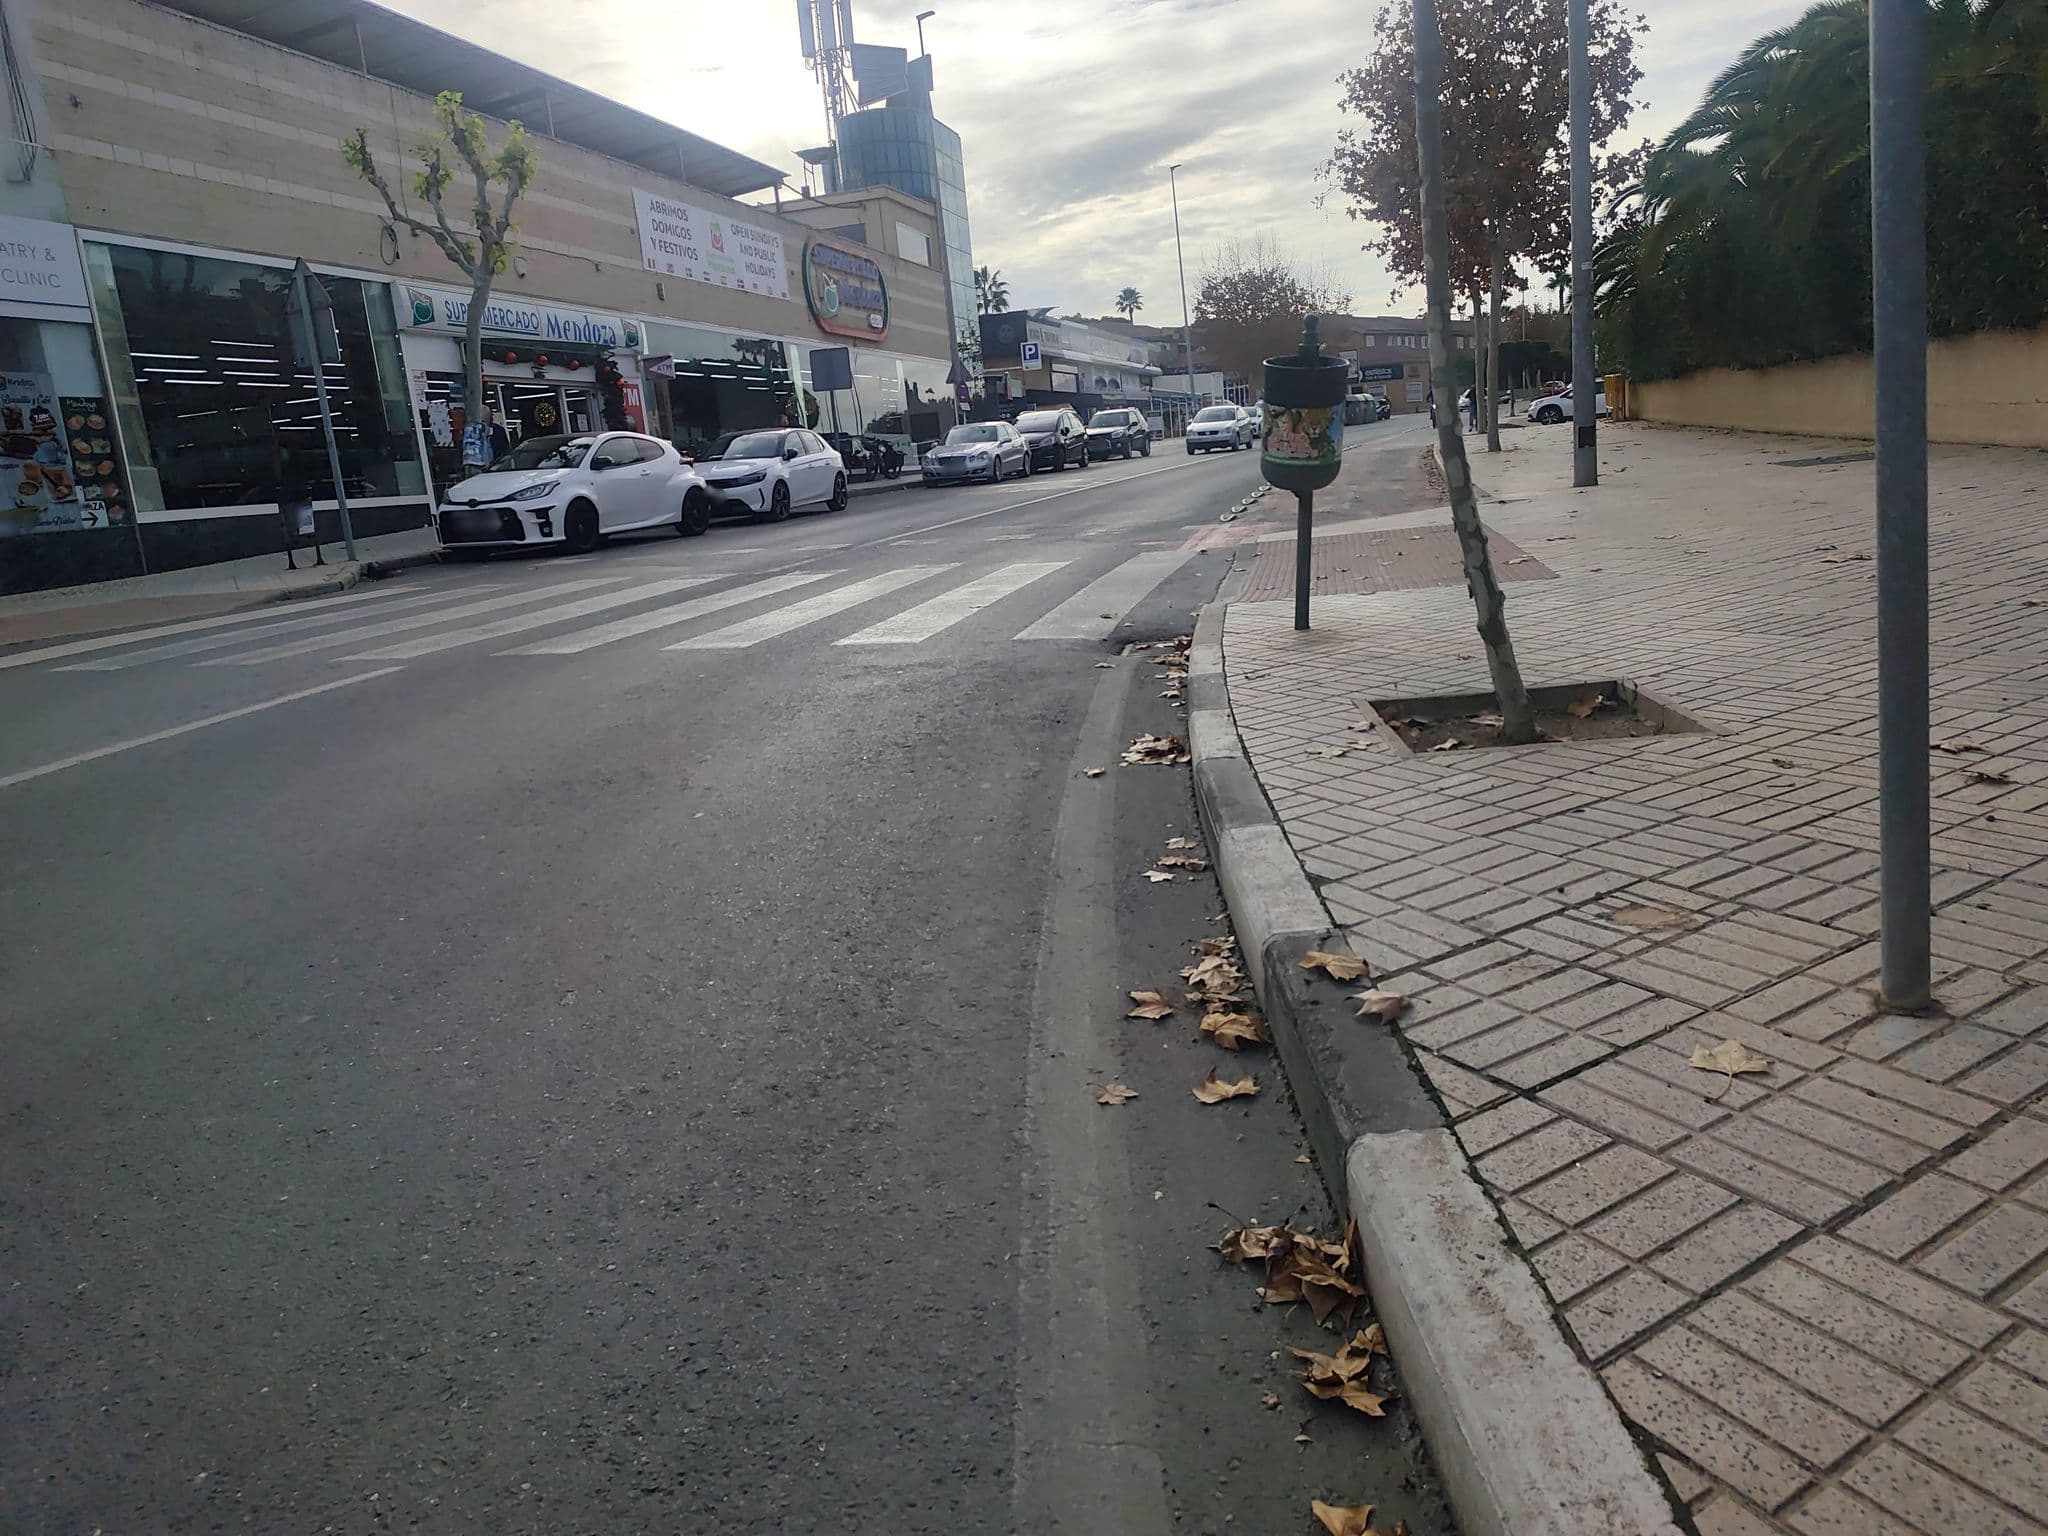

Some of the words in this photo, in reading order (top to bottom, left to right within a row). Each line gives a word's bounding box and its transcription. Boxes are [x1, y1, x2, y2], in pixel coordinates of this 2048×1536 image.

[650, 200, 689, 222] ABRIMOS
[651, 218, 692, 241] DOMIGOS
[730, 223, 750, 240] OPEN
[750, 229, 780, 249] SUNDAYS
[44, 247, 56, 262] &
[650, 236, 658, 251] Y
[658, 240, 699, 261] FESTIVOS
[1, 268, 61, 289] CLINIC
[744, 260, 777, 280] HOLIDAYS
[444, 300, 541, 331] SUPMERCADO
[545, 312, 618, 346] Mendoza
[1025, 345, 1036, 360] P
